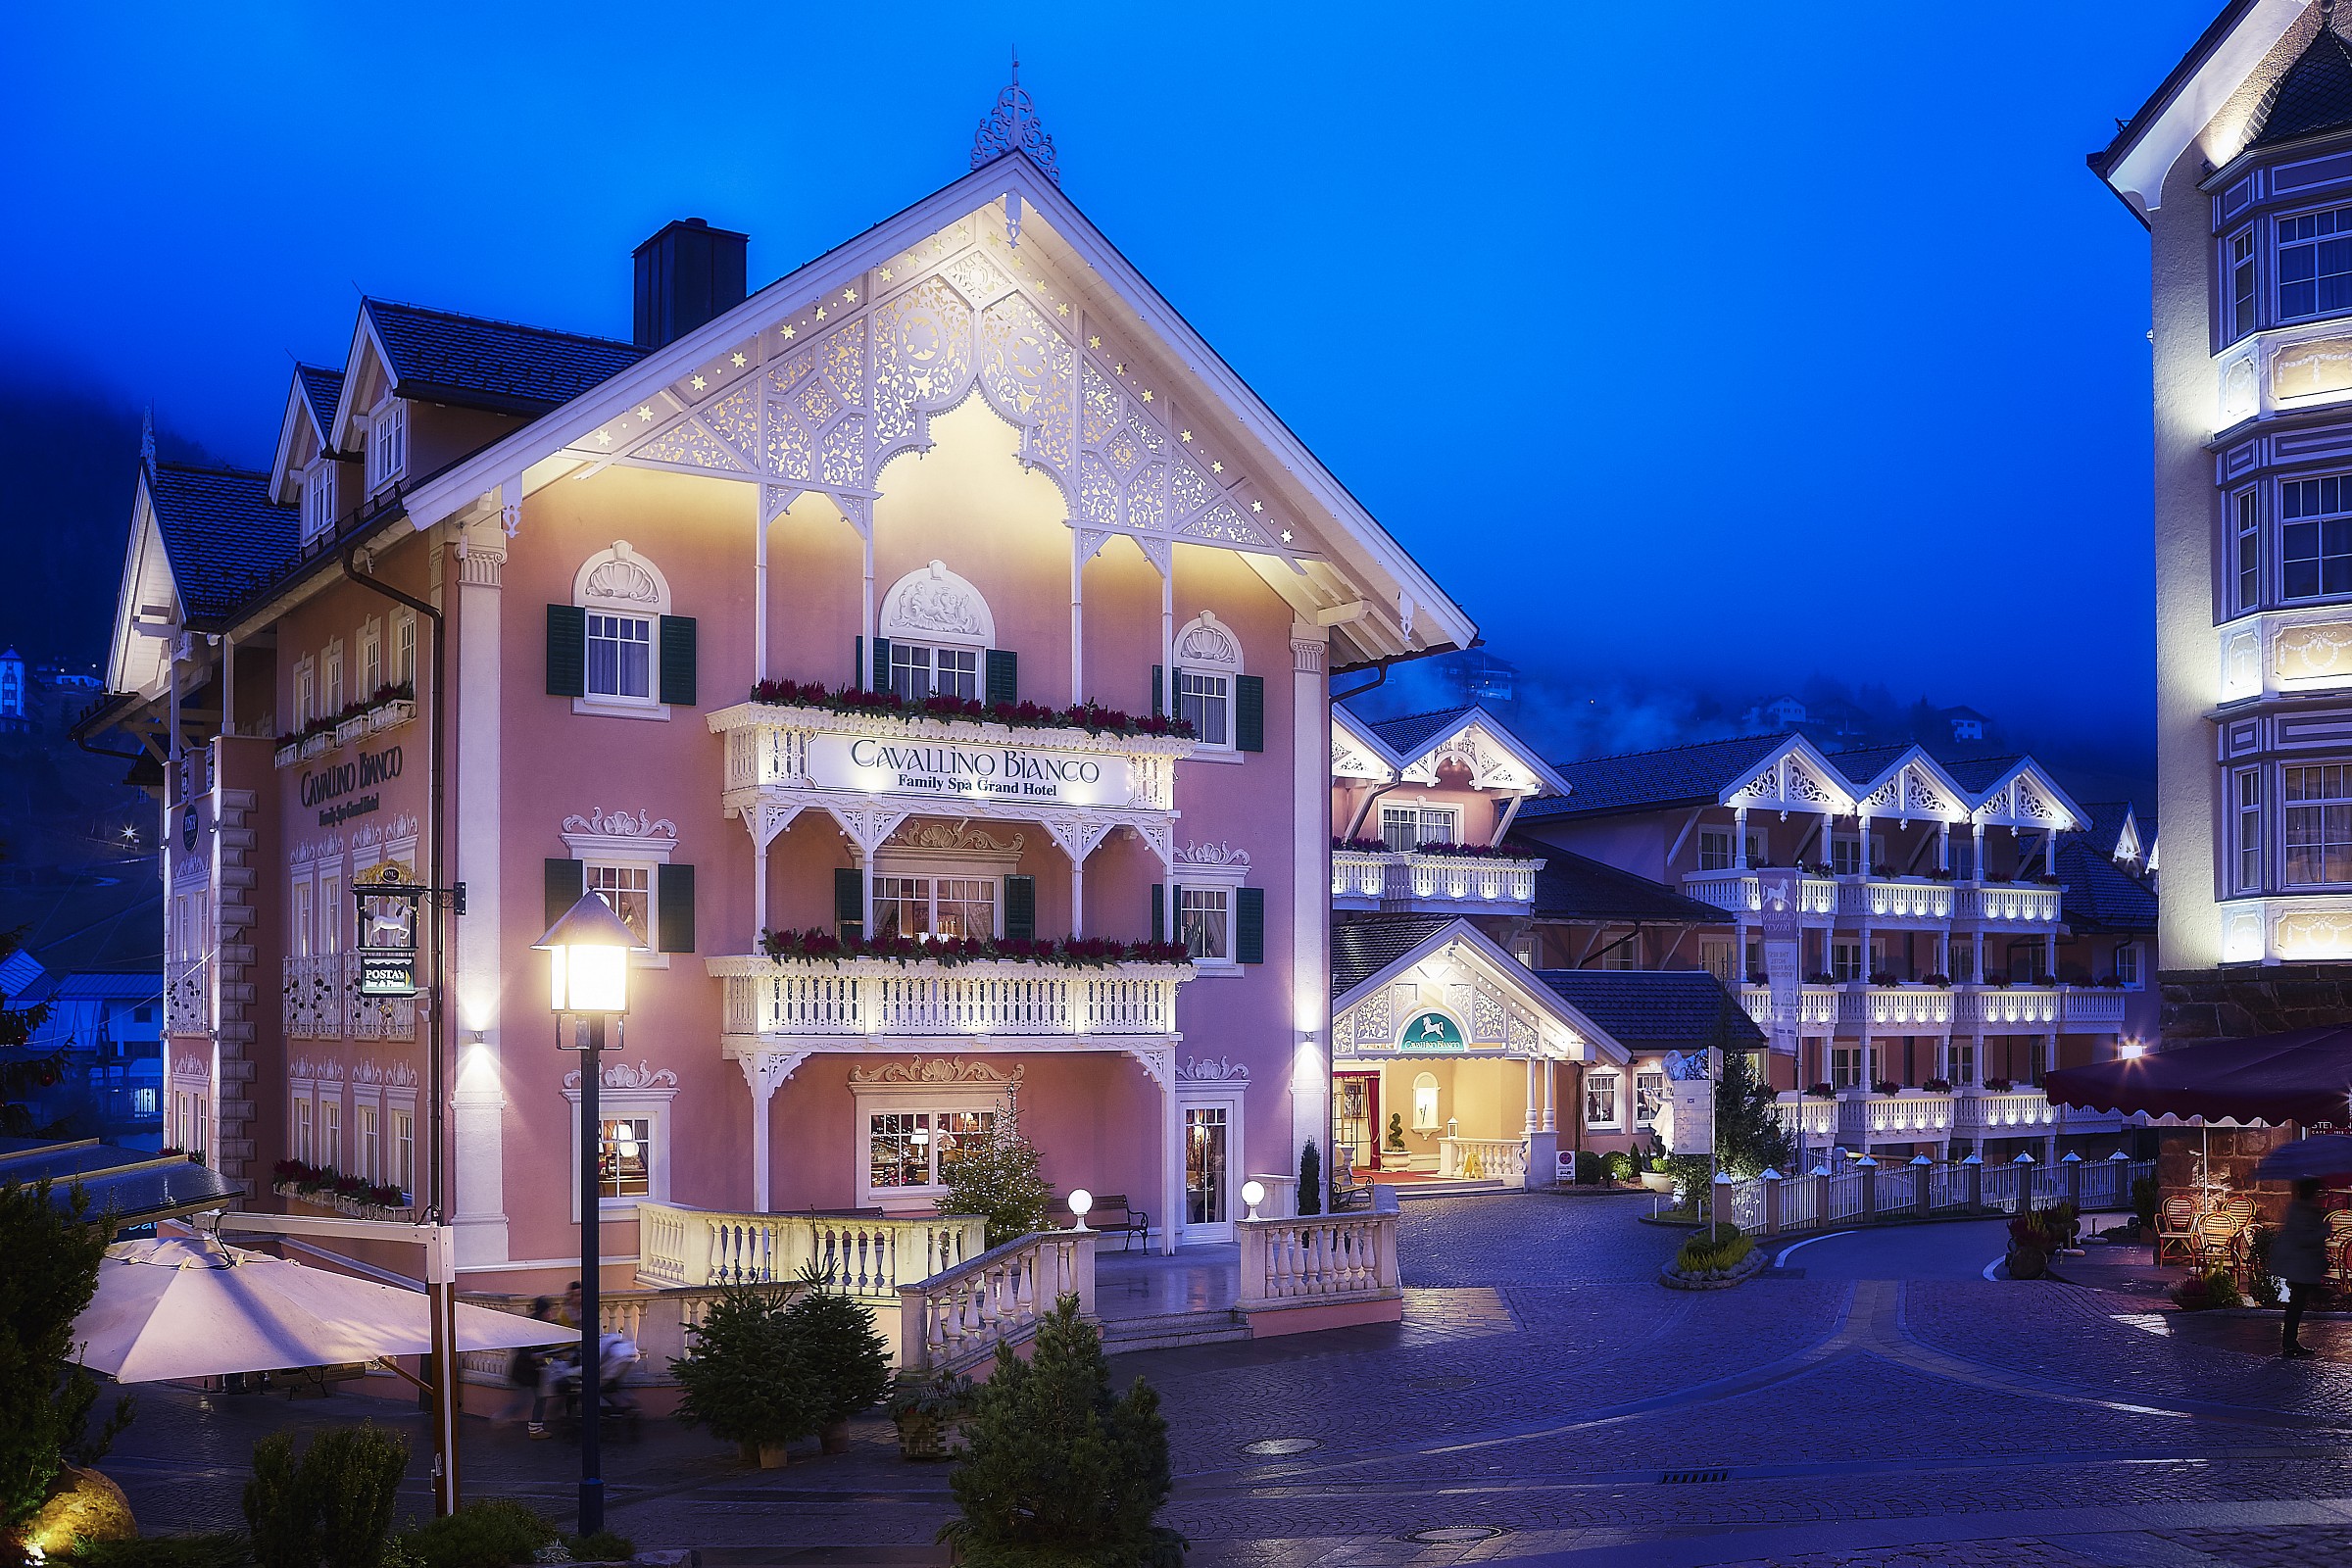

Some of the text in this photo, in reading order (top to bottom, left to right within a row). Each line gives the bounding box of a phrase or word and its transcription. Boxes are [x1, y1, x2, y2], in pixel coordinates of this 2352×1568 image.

[898, 774, 1057, 796] Family Spa Grand Hotel
